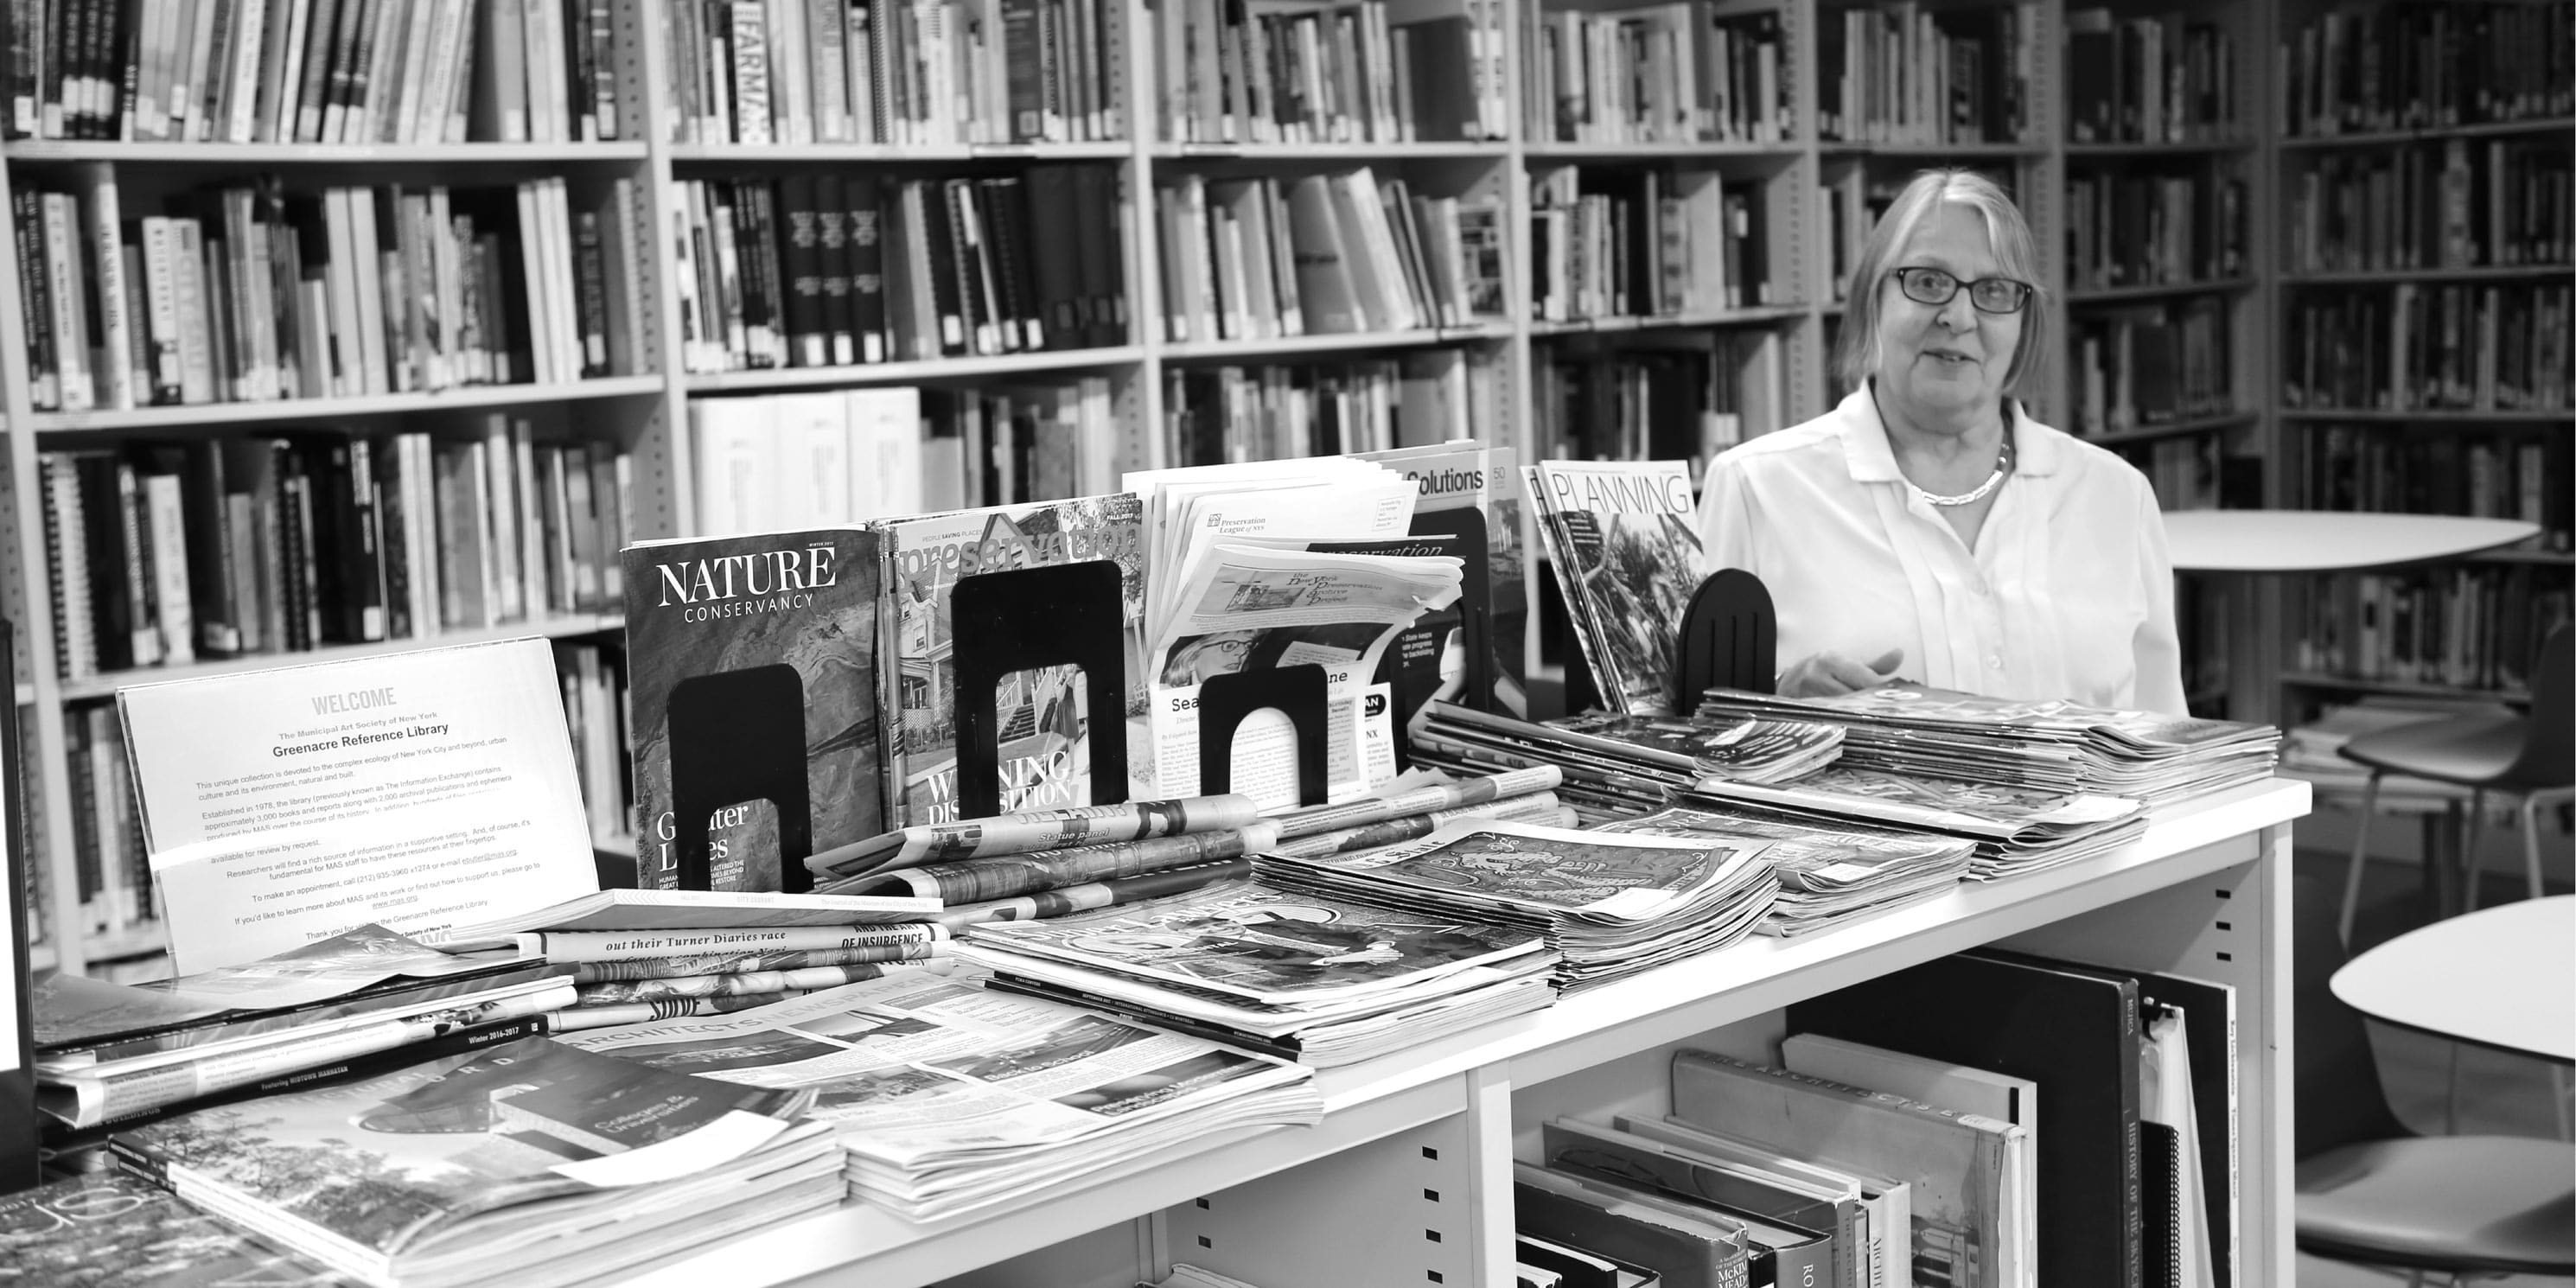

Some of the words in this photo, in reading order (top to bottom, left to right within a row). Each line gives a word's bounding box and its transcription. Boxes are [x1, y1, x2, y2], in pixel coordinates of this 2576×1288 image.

[1408, 468, 1482, 496] Solutions
[1494, 467, 1506, 479] 50
[1553, 474, 1688, 513] PLANNING
[961, 529, 982, 538] PLACES
[1219, 526, 1245, 534] League
[1221, 517, 1266, 527] Preservation
[899, 523, 1141, 593] preservation
[656, 546, 837, 608] NATURE
[685, 593, 814, 624] CONSERVANCY
[1327, 672, 1348, 683] ne
[311, 687, 398, 716] WELCOME
[1172, 697, 1199, 711] Sea
[272, 741, 337, 756] Greenacre
[341, 731, 403, 746] Reference
[406, 724, 448, 736] Library
[296, 725, 338, 736] Municipal
[355, 719, 386, 728] Society
[195, 781, 212, 790] This
[214, 778, 239, 787] unique
[240, 773, 274, 782] collection
[283, 765, 311, 775] devoted
[334, 759, 362, 768] complex
[364, 755, 390, 763] ecology
[928, 750, 1069, 806] WNING
[197, 792, 223, 802] culture
[225, 787, 239, 796] and
[298, 775, 322, 784] natural
[201, 806, 245, 819] Established
[313, 790, 349, 802] (previously
[400, 777, 437, 787] Information
[438, 770, 473, 781] Exchange)
[929, 781, 1070, 825] DISSITION
[657, 806, 749, 841] Gater
[1038, 832, 1075, 842] Statue
[1078, 828, 1109, 838] panel
[659, 838, 728, 871] Les
[713, 861, 733, 871] ALTERED
[716, 877, 736, 885] RESTORE
[723, 868, 743, 877] BEYOND
[606, 941, 626, 950] out
[631, 938, 661, 948] their
[666, 937, 709, 946] Turner
[713, 928, 756, 943] Diaries
[761, 930, 785, 940] race
[842, 937, 856, 948] OF
[858, 934, 923, 947] INSURGENCE
[567, 1017, 764, 1048] ARCHITECTS
[762, 973, 932, 1025] NEWSPAPER
[469, 1035, 488, 1043] Winter
[488, 1026, 519, 1039] 2016-2017
[984, 1068, 1024, 1081] Back
[1041, 1049, 1094, 1068] School
[261, 1080, 288, 1089] Featuring
[290, 1073, 316, 1083] MIDTOWN
[595, 1102, 668, 1129] Colleges
[606, 1096, 698, 1134] Universities
[2128, 1122, 2139, 1179] HISTORY
[2130, 1185, 2139, 1202] OF
[2130, 1208, 2139, 1236] THE
[1718, 1261, 1747, 1283] McKIM
